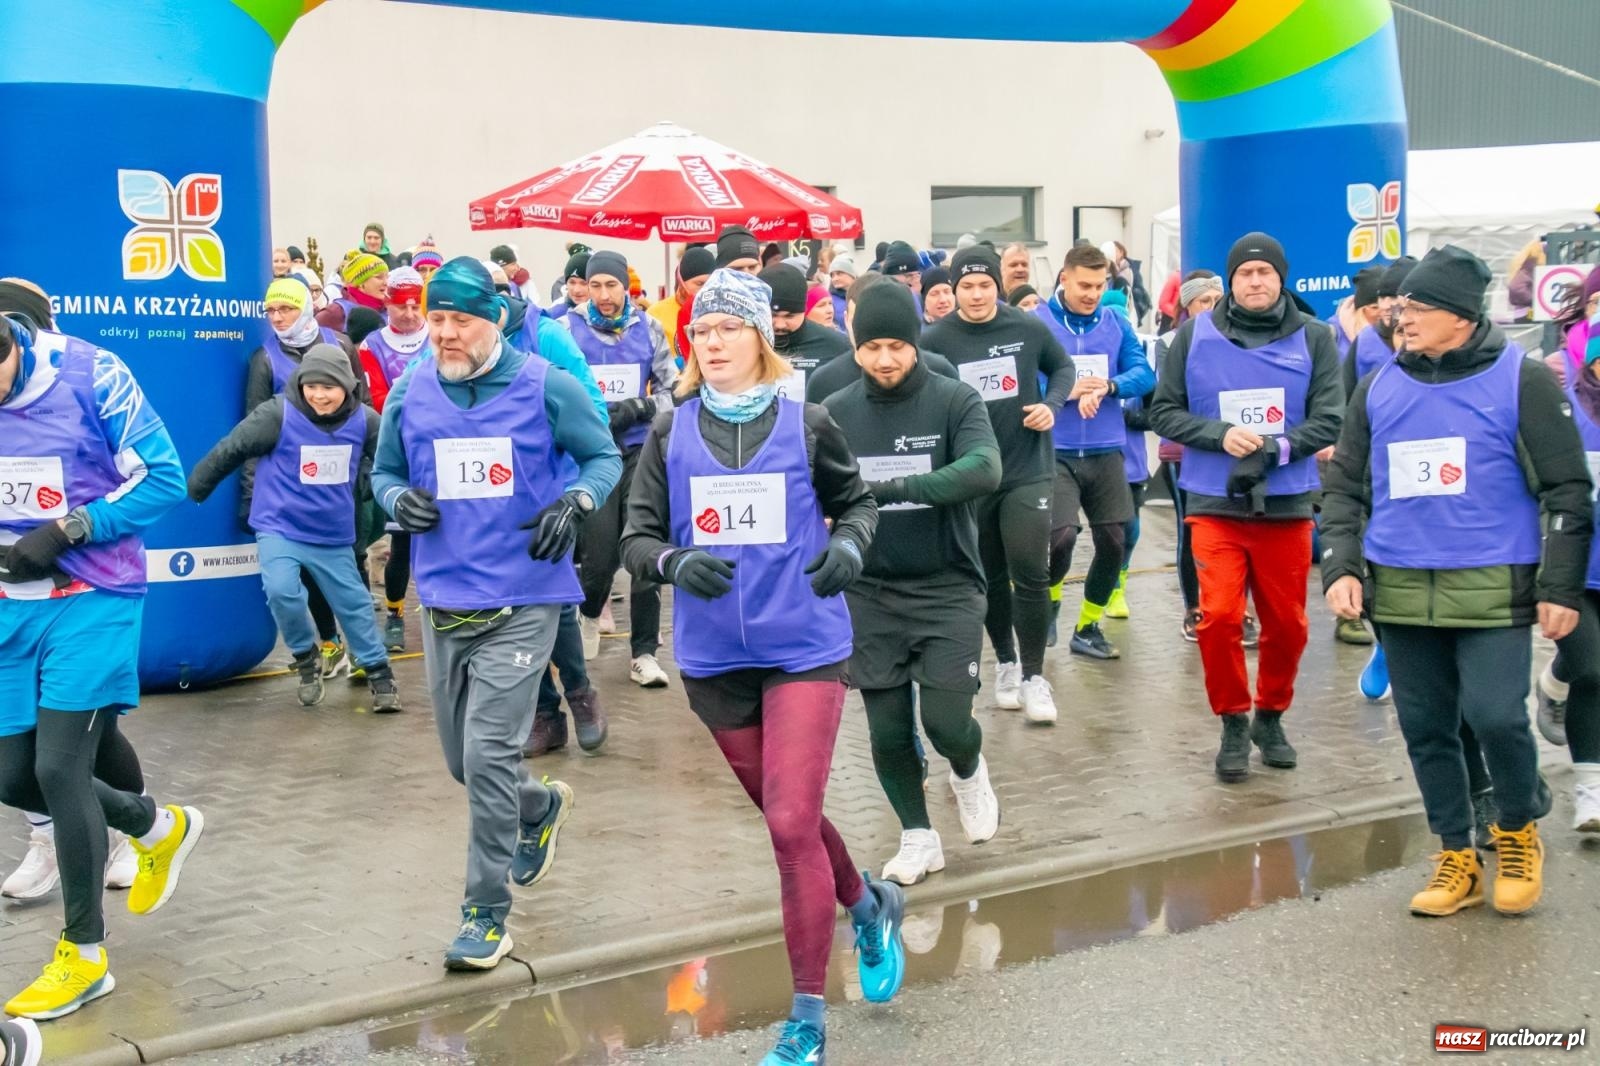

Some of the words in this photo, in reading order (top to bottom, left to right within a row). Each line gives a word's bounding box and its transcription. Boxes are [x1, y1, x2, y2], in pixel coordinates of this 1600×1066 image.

[580, 156, 639, 199] WARKA
[590, 211, 632, 227] Classic
[666, 219, 710, 230] WARKA
[1296, 275, 1350, 292] GMINA
[51, 295, 127, 315] GMINA
[100, 328, 139, 340] odkryj
[148, 329, 186, 340] poznaj
[194, 330, 244, 342] zapamiętaj
[606, 379, 625, 394] 42
[980, 374, 1000, 391] 75
[1241, 407, 1264, 424] 65
[458, 461, 486, 483] 13
[1417, 461, 1430, 482] 3
[1, 482, 32, 505] 37
[723, 504, 756, 530] 14
